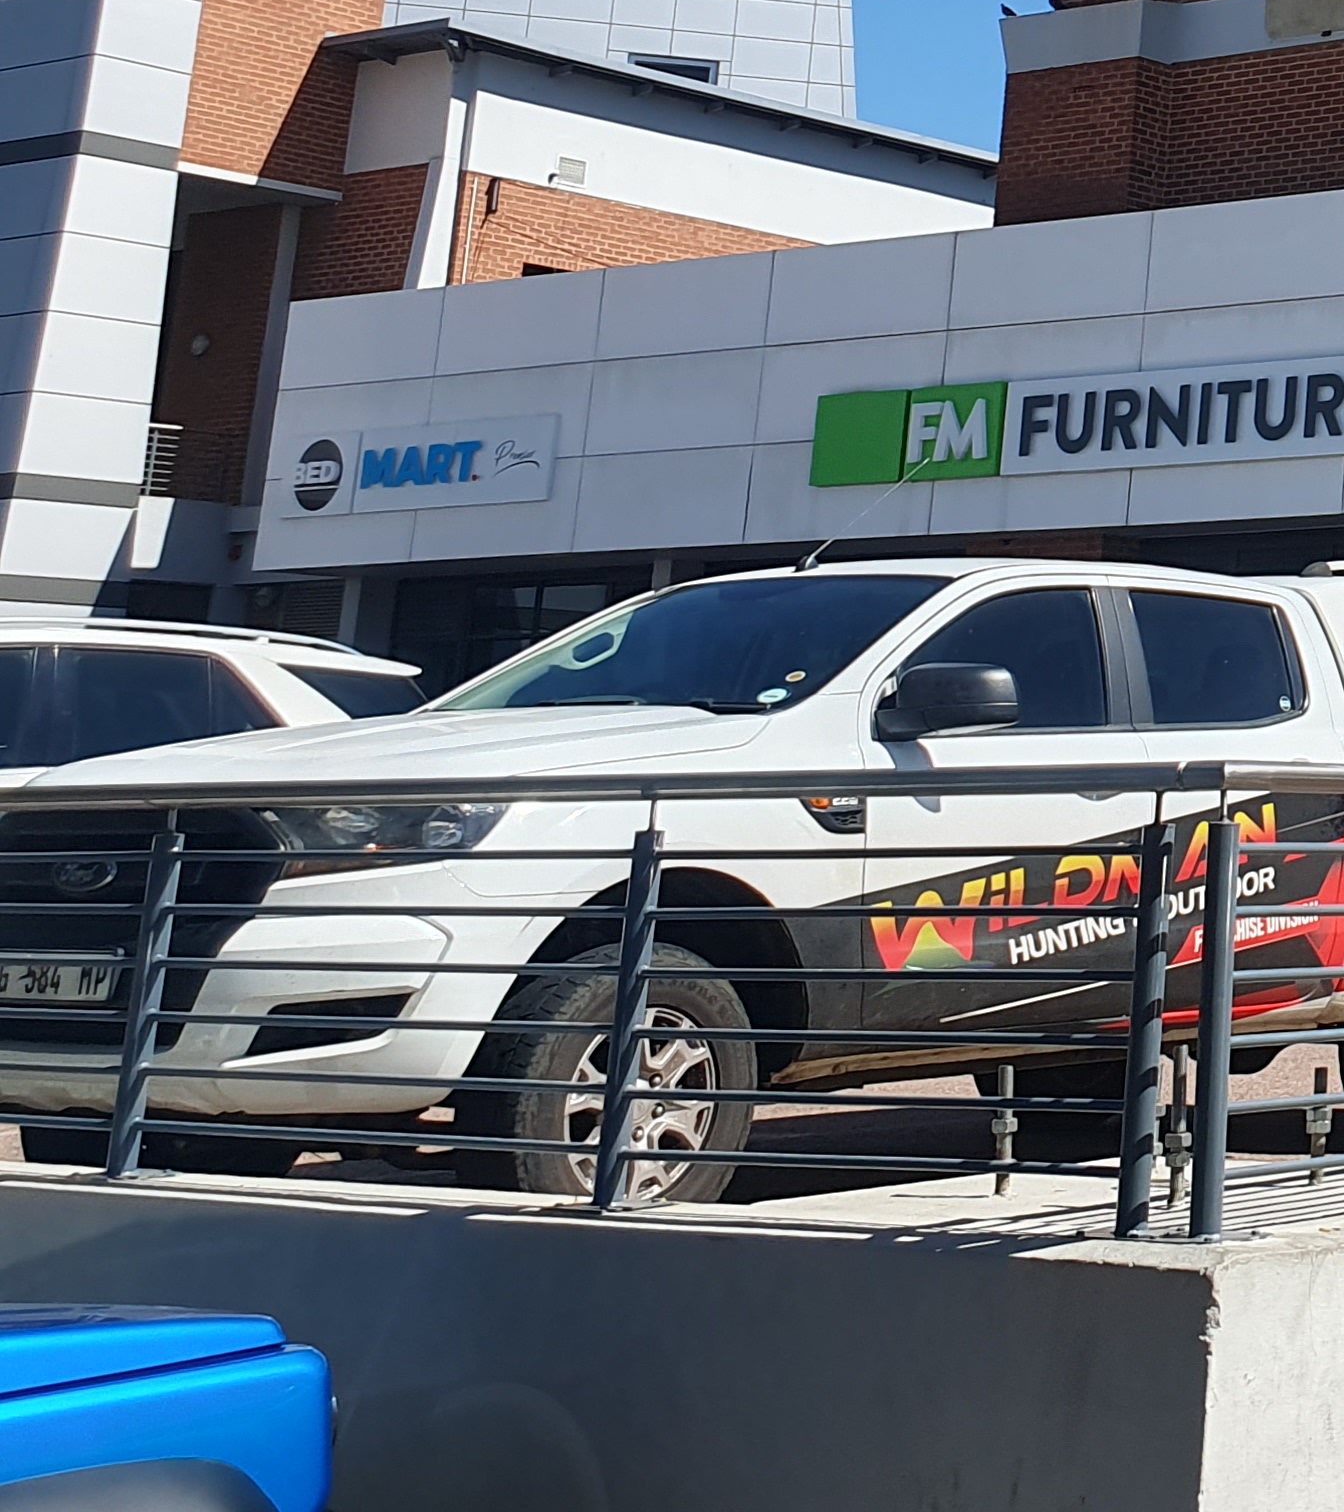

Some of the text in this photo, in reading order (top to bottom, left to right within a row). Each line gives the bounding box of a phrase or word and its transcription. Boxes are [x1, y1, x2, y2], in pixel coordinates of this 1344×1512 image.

[907, 398, 988, 463] FM
[294, 460, 341, 485] BED
[1009, 866, 1276, 965] HUNTING OUTOR
